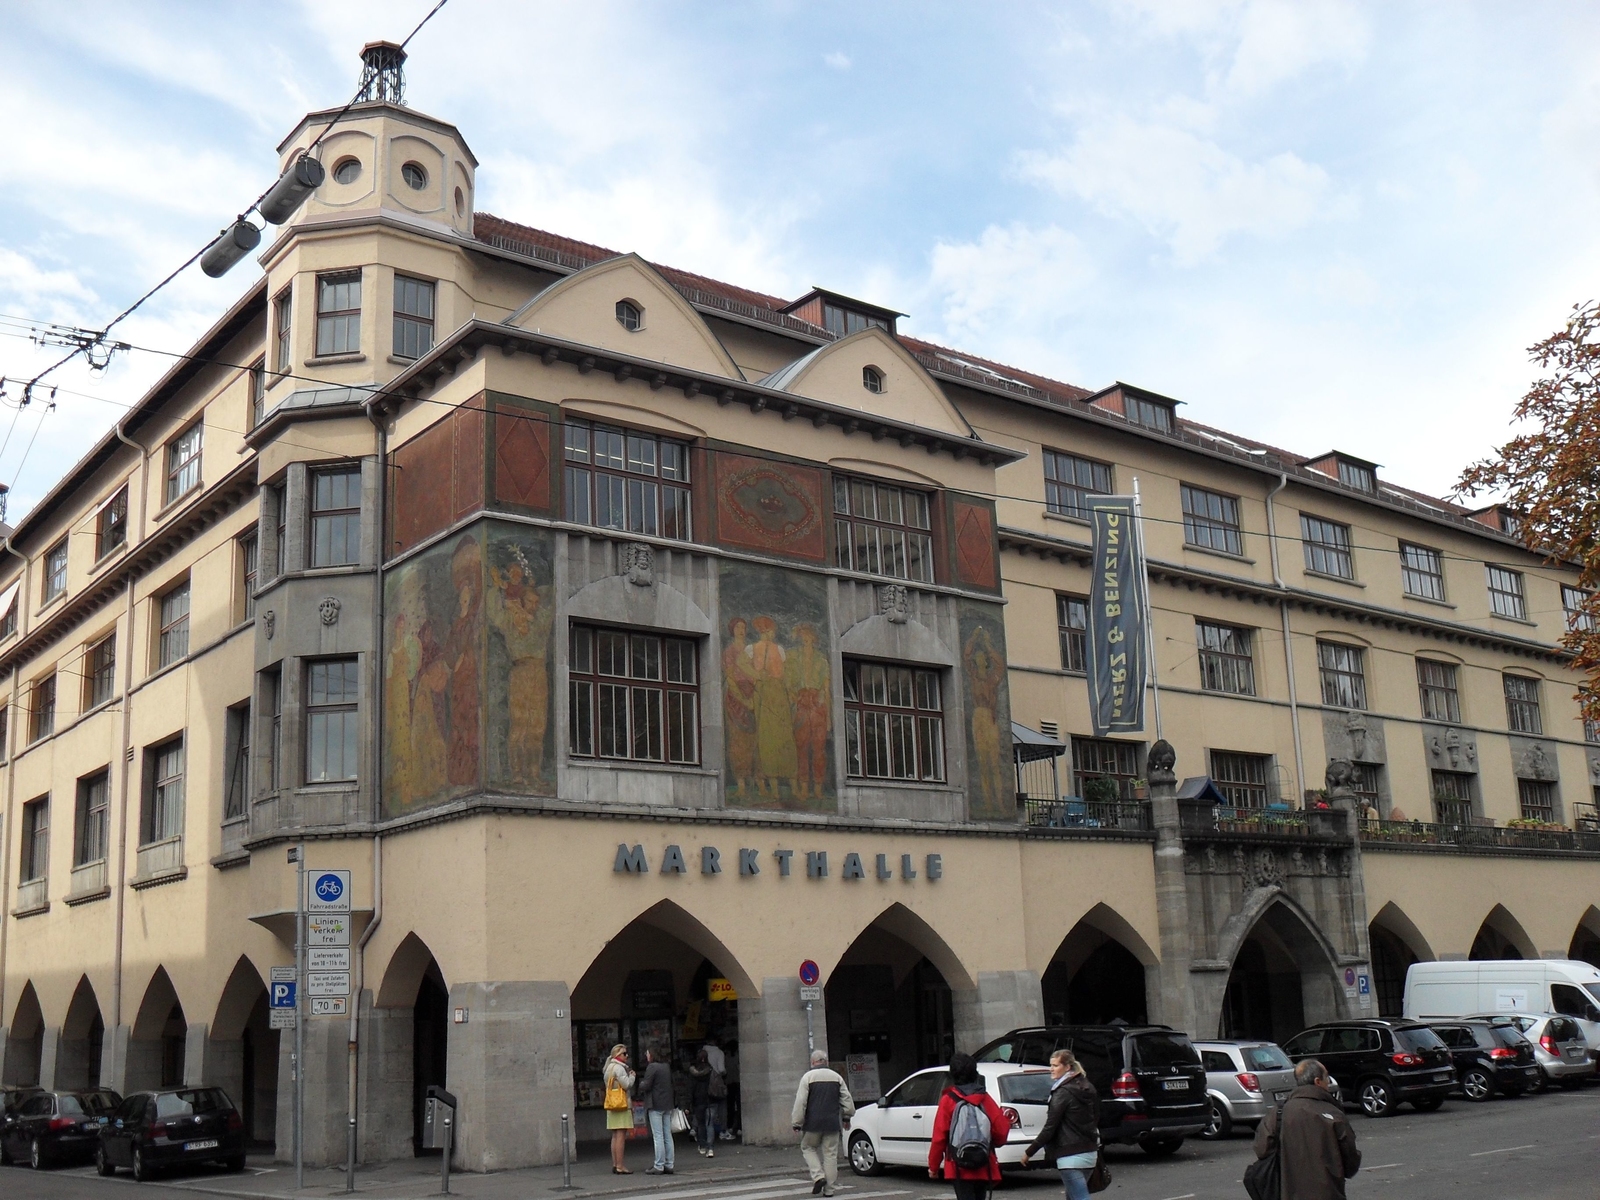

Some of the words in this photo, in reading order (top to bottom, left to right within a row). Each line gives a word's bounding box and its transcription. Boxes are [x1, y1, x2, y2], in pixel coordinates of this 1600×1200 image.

[613, 843, 942, 879] MARKTHALLE
[322, 935, 336, 943] frei
[1359, 977, 1366, 993] P
[274, 984, 289, 1005] P
[317, 1001, 329, 1011] 70
